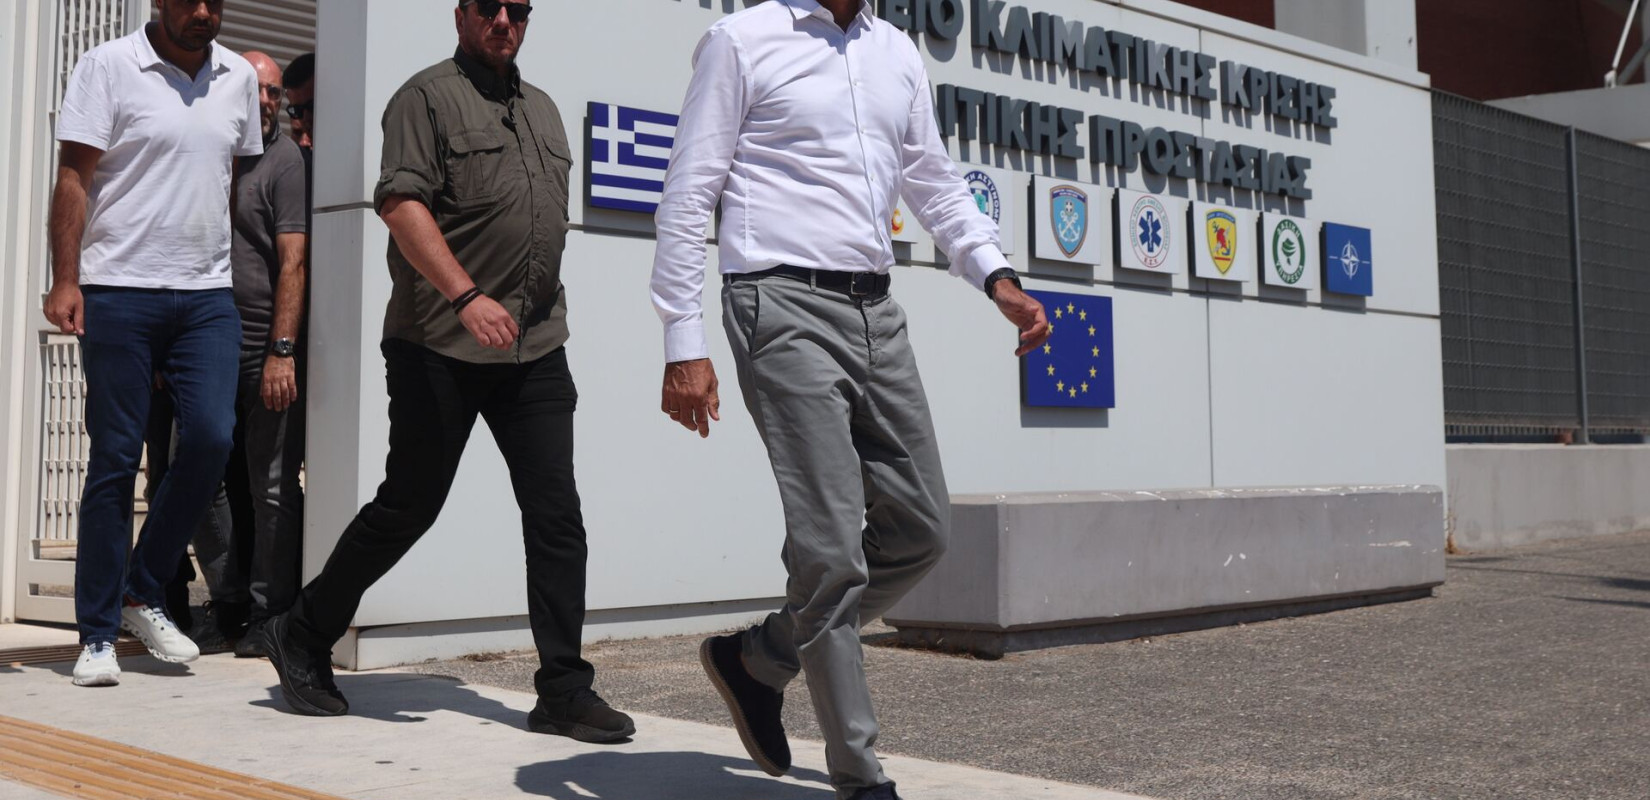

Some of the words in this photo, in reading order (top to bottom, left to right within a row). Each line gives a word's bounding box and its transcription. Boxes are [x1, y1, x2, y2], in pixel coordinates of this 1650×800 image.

[971, 0, 1217, 101] ΚΛΙΜΑΤΙΚΗΣ
[1220, 60, 1338, 128] ΚΡΙΣΗΣ
[929, 80, 1084, 159] ΙΤΙΚΗΣ
[1089, 114, 1313, 200] ΠΡΟΣΤΑΣΙΑΣ
